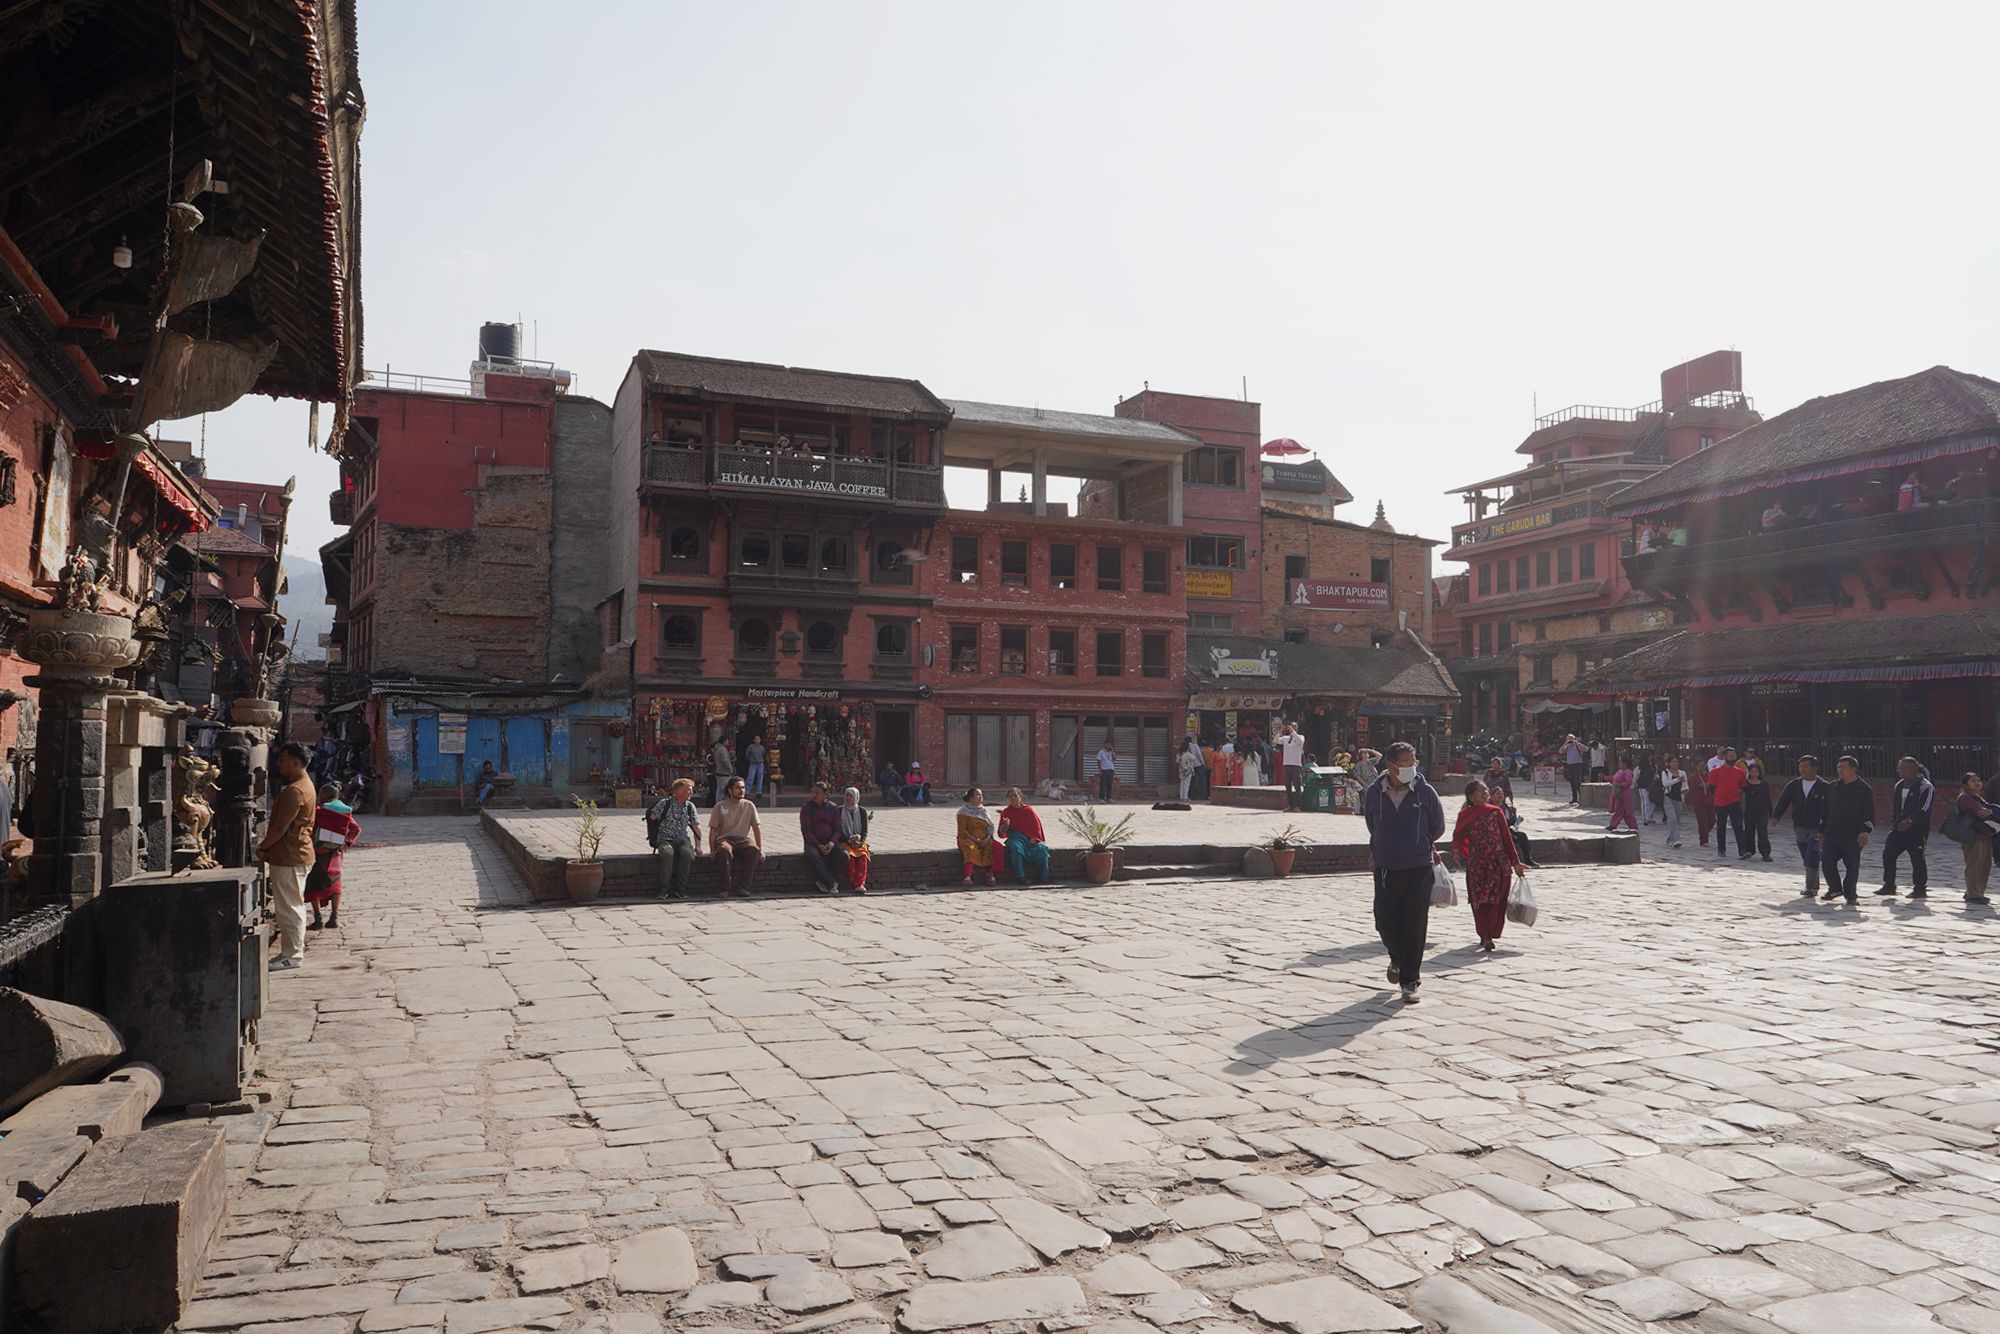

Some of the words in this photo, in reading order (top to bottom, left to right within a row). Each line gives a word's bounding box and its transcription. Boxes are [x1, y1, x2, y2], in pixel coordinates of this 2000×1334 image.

[721, 472, 803, 489] HIMALAYAN
[806, 480, 836, 492] JAVA
[839, 483, 886, 497] COFFEE
[1491, 523, 1505, 537] THE
[1506, 517, 1534, 533] GARUDA
[1535, 512, 1551, 527] BAR
[1316, 585, 1388, 598] BHAKTAPUR.COM
[748, 688, 795, 698] Masterpiece
[798, 689, 839, 698] Handicraft
